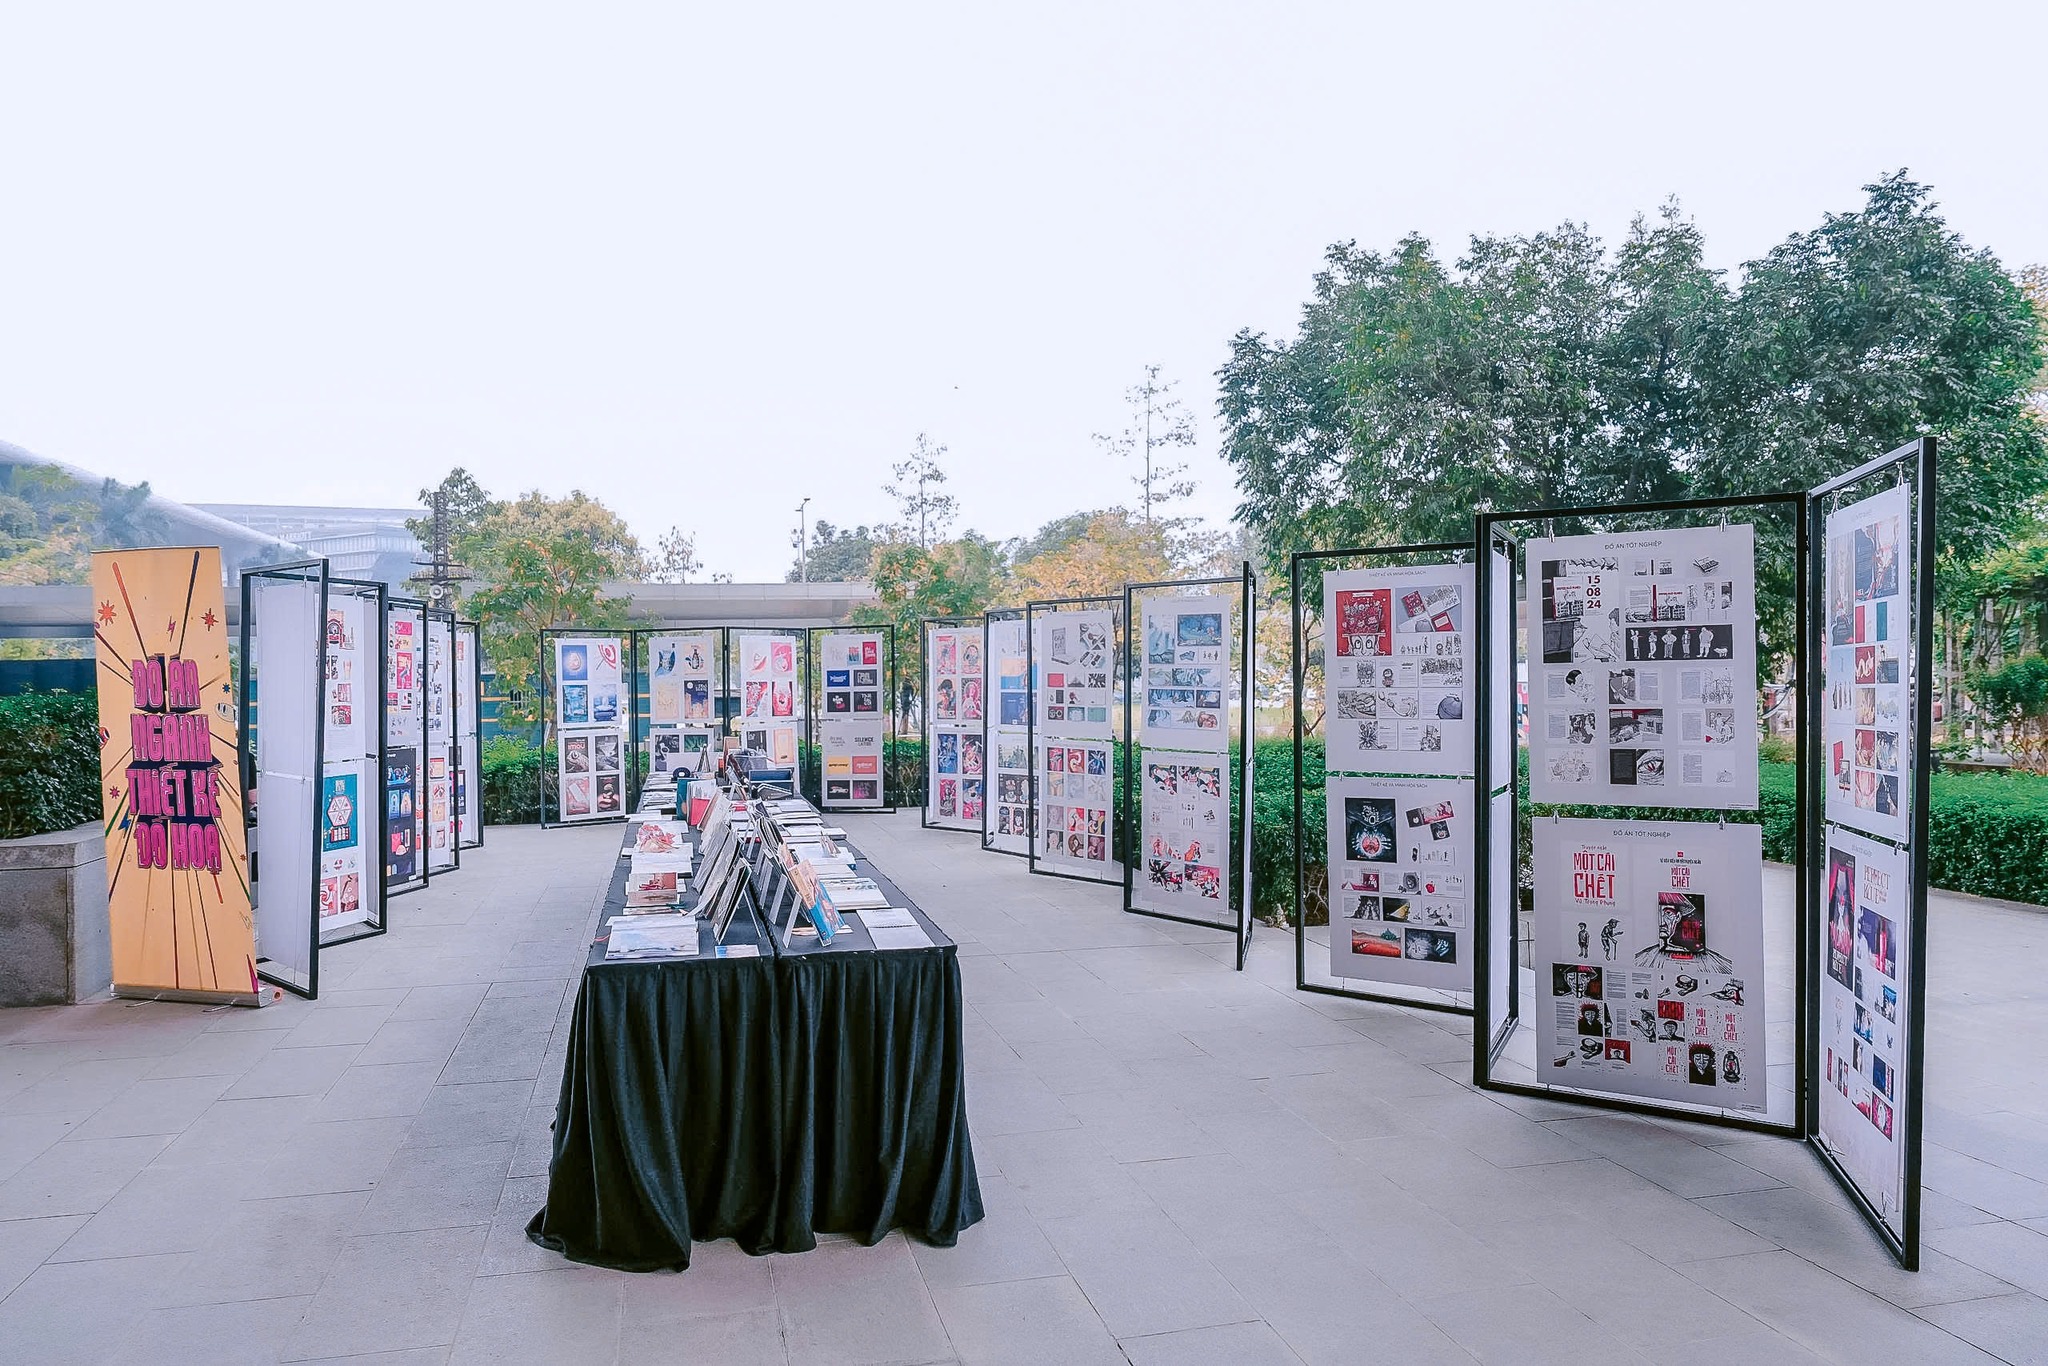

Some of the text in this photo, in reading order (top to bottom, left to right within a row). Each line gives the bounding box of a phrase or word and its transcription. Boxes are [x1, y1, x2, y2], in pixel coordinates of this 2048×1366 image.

[1588, 575, 1600, 584] 15
[1586, 588, 1601, 596] 08
[1587, 600, 1601, 609] 24
[131, 653, 164, 708] ĐỒ
[192, 763, 222, 818] KẾ
[134, 816, 167, 869] ĐỒ
[1574, 850, 1616, 872] MỘT CÁI
[1574, 872, 1615, 899] CHẾT
